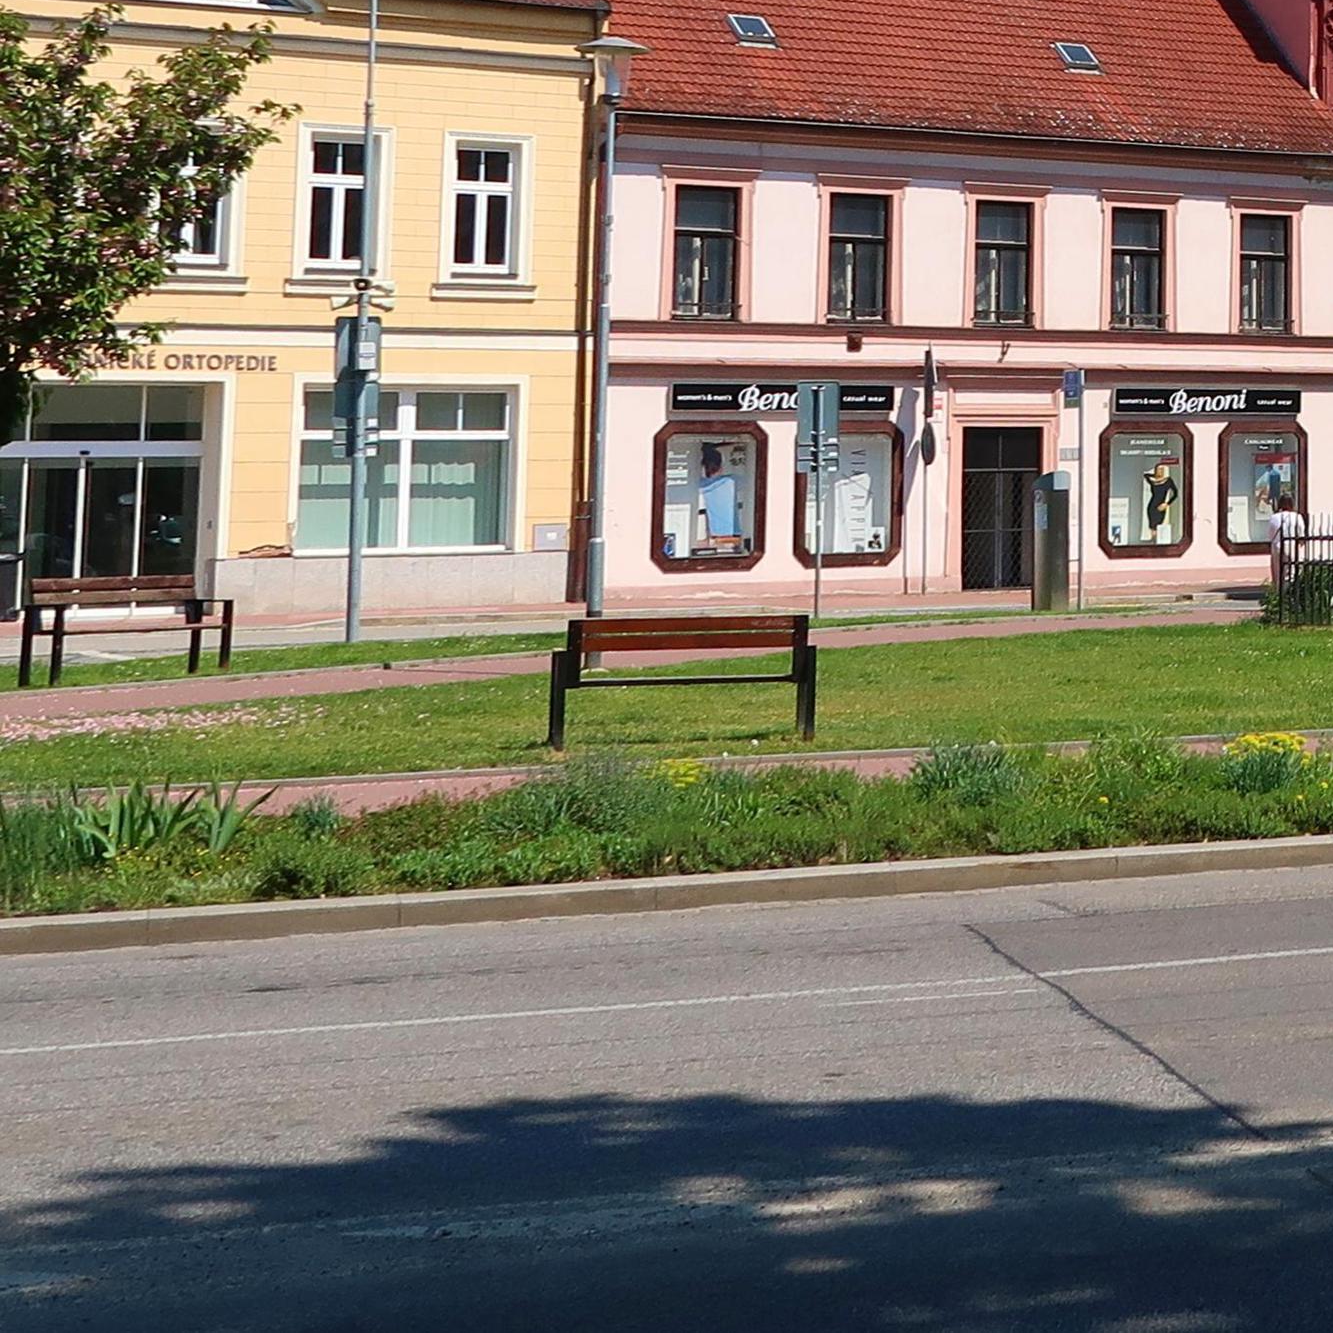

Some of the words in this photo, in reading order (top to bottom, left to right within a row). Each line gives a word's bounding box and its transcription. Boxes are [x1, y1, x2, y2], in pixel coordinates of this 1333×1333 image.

[164, 353, 278, 372] ORTOPEDIE
[737, 384, 800, 412] Beno
[842, 394, 866, 402] casual
[1169, 389, 1248, 414] Benoni
